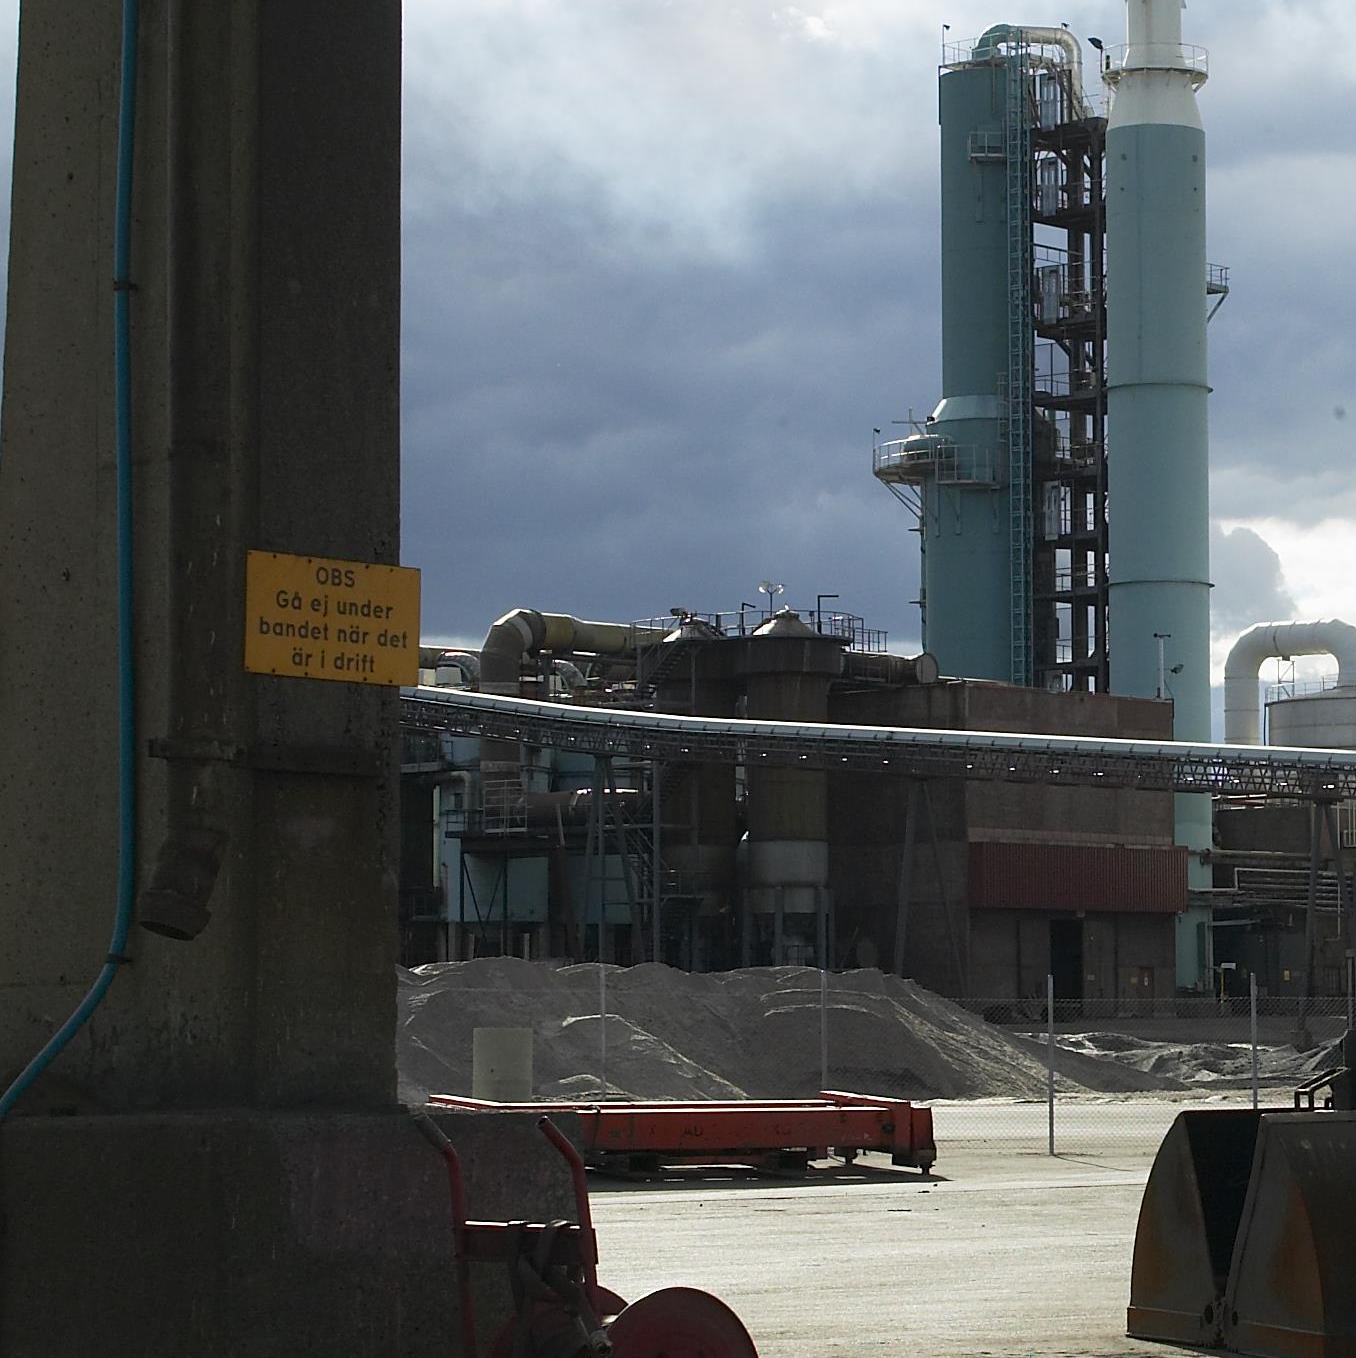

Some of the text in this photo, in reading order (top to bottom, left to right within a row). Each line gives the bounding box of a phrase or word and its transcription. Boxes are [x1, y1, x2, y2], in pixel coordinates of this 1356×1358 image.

[316, 567, 355, 588] OBS
[276, 590, 394, 620] Gå ej under
[259, 616, 408, 649] bandet när det
[292, 647, 375, 673] är i drift
